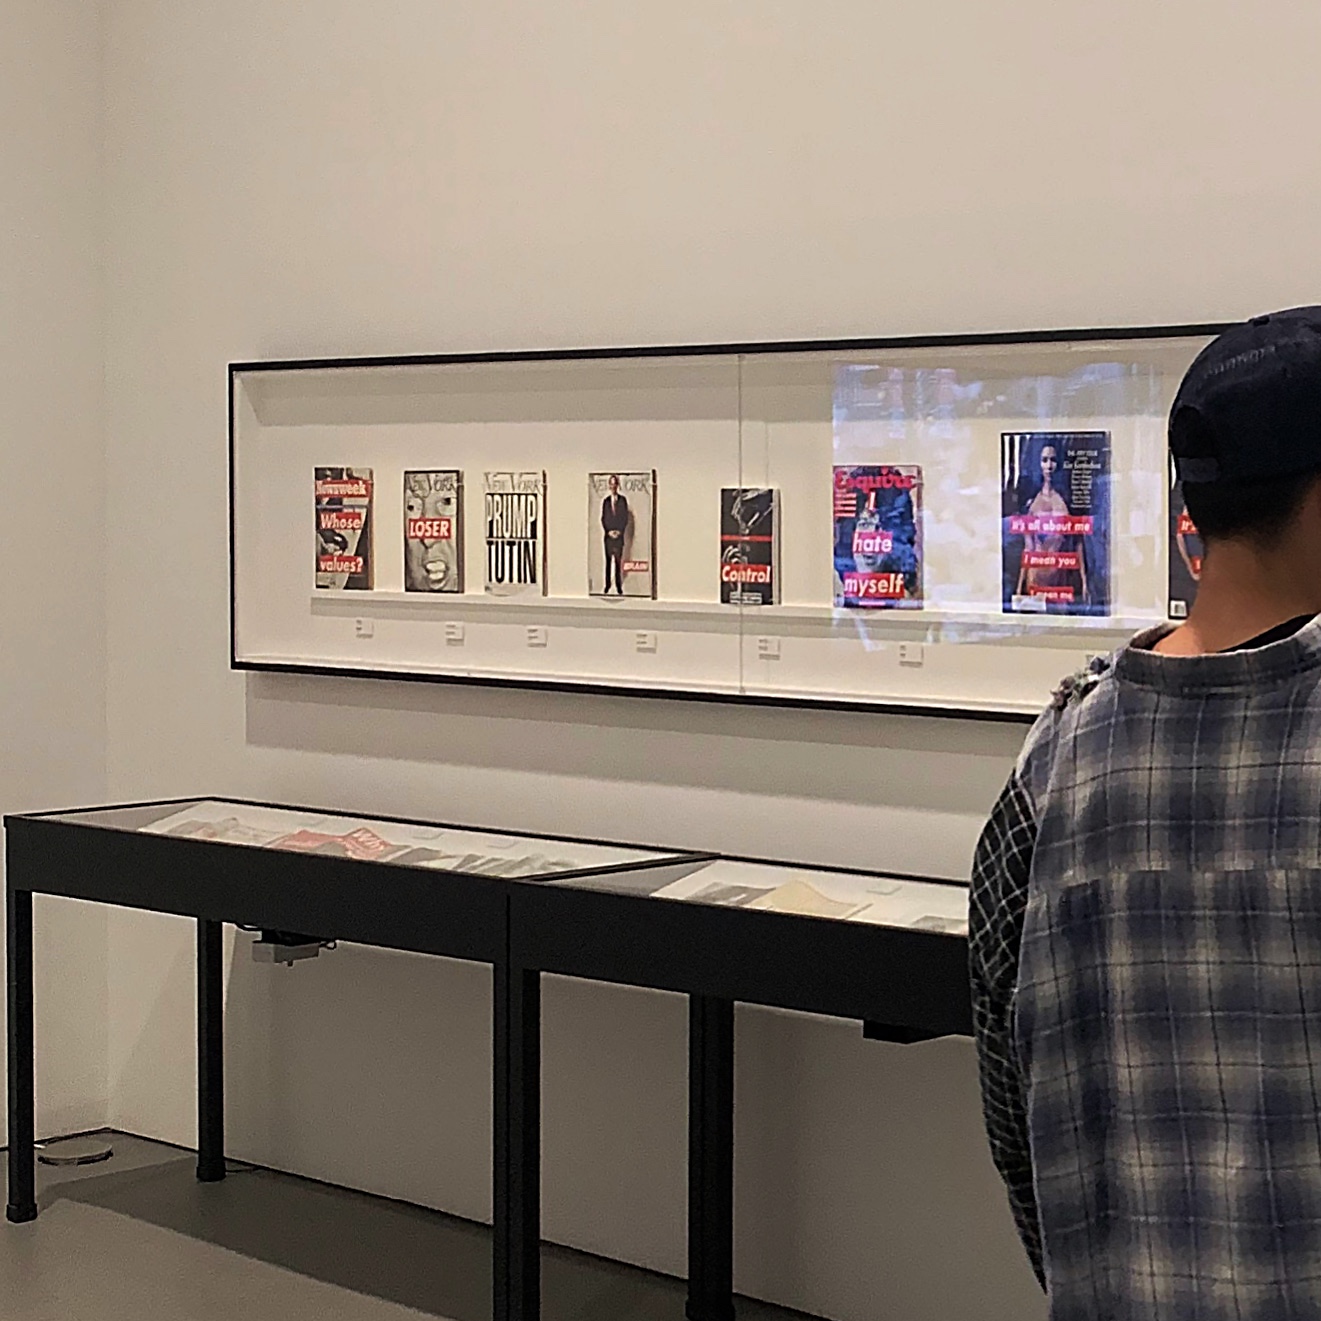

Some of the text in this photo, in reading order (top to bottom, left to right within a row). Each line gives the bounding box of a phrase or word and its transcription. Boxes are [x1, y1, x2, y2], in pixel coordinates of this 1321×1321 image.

[320, 513, 361, 529] Whose
[486, 495, 536, 538] PRUMP
[1042, 519, 1072, 531] about
[1074, 523, 1090, 531] me
[409, 521, 449, 537] LOSER
[853, 532, 892, 552] hate
[320, 556, 363, 573] values?
[486, 541, 537, 583] TUTIN
[1030, 557, 1056, 565] mean
[1058, 556, 1076, 568] you
[722, 565, 771, 582] Control
[844, 573, 904, 597] myself
